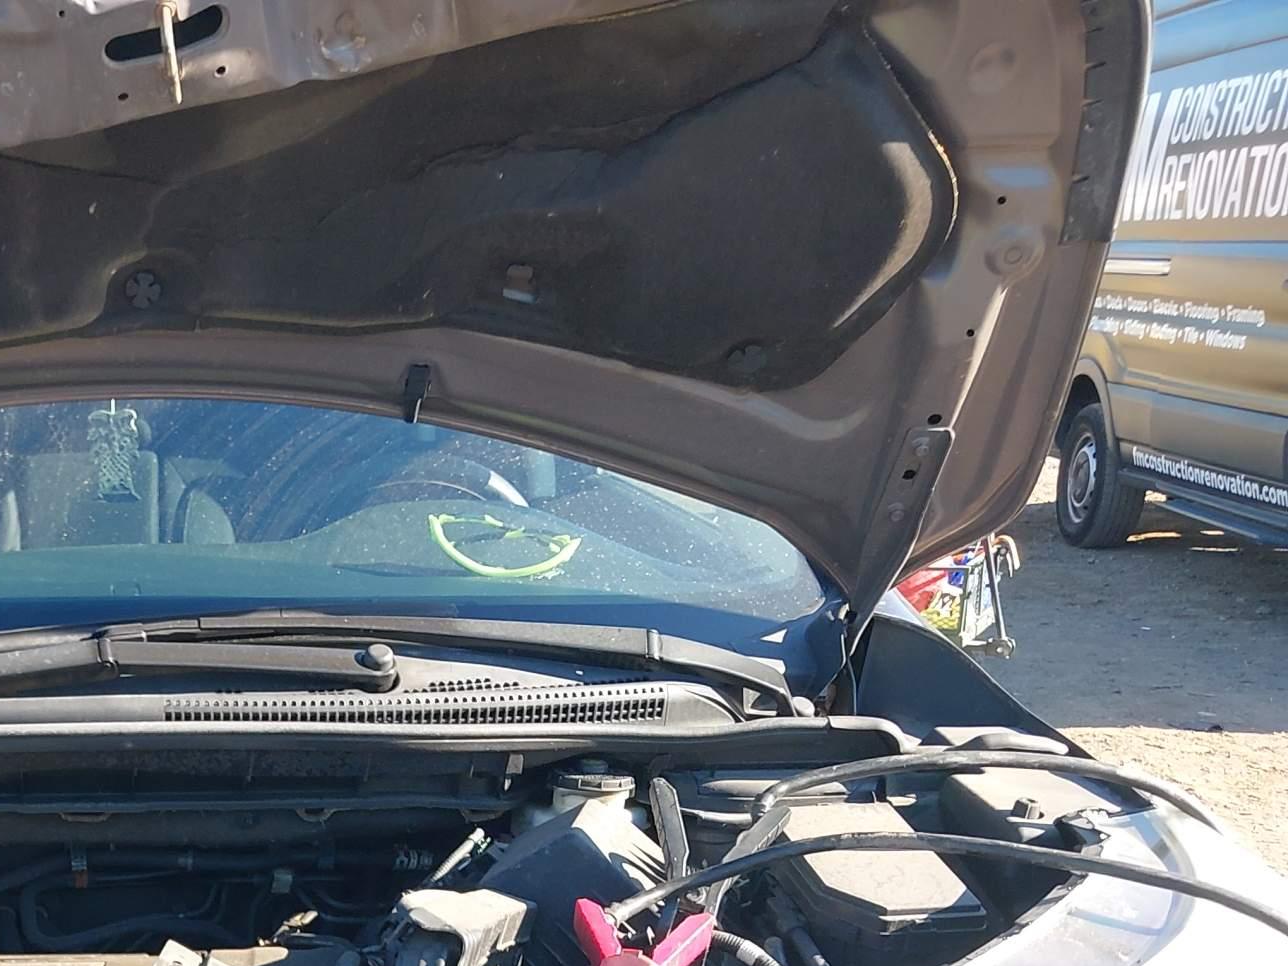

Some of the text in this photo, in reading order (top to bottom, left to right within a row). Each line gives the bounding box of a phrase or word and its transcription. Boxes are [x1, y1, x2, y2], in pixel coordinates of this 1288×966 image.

[1155, 141, 1288, 221] RENOVATIO
[1226, 304, 1266, 328] Framing
[1183, 326, 1199, 345] Tile
[1205, 326, 1248, 351] Windows
